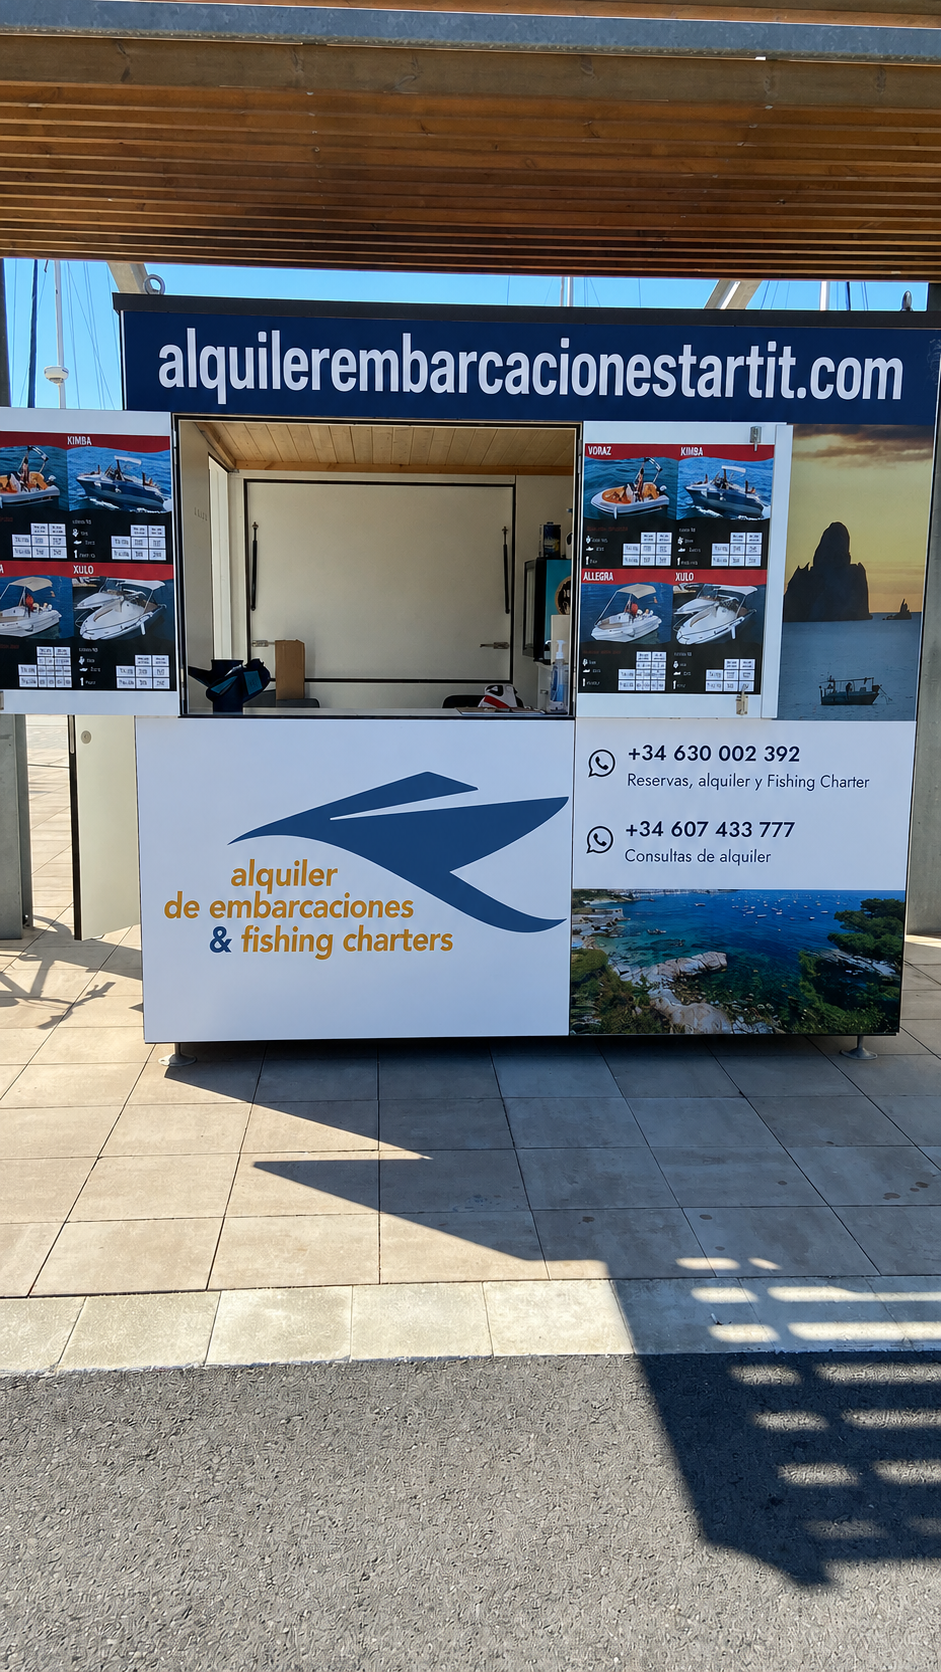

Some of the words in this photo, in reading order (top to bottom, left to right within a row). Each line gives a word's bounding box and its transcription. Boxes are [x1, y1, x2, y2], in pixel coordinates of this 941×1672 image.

[158, 327, 904, 405] alquilerembarcacionestartit.com
[67, 436, 92, 446] KIMBA
[73, 565, 94, 575] XULO
[583, 572, 614, 582] ALLEGRA
[675, 572, 694, 582] XULO
[628, 745, 667, 762] +34
[673, 745, 712, 763] 630
[718, 746, 757, 763] 002
[763, 746, 801, 763] 392
[627, 773, 693, 790] Reservas,
[698, 773, 751, 790] alquiler
[754, 779, 763, 791] y
[767, 774, 815, 791] Fishing
[820, 775, 870, 788] Charter
[625, 821, 664, 837] +34
[671, 821, 710, 838] 607
[715, 821, 753, 838] 433
[759, 821, 796, 838] 777
[625, 848, 692, 863] Consultas
[696, 849, 716, 863] de
[719, 849, 771, 866] alquiler
[230, 858, 338, 895] alquiler
[163, 890, 200, 919] de
[209, 890, 414, 919] embarcaciones
[209, 925, 233, 953] &
[241, 924, 333, 960] fishing
[342, 924, 453, 952] charters
